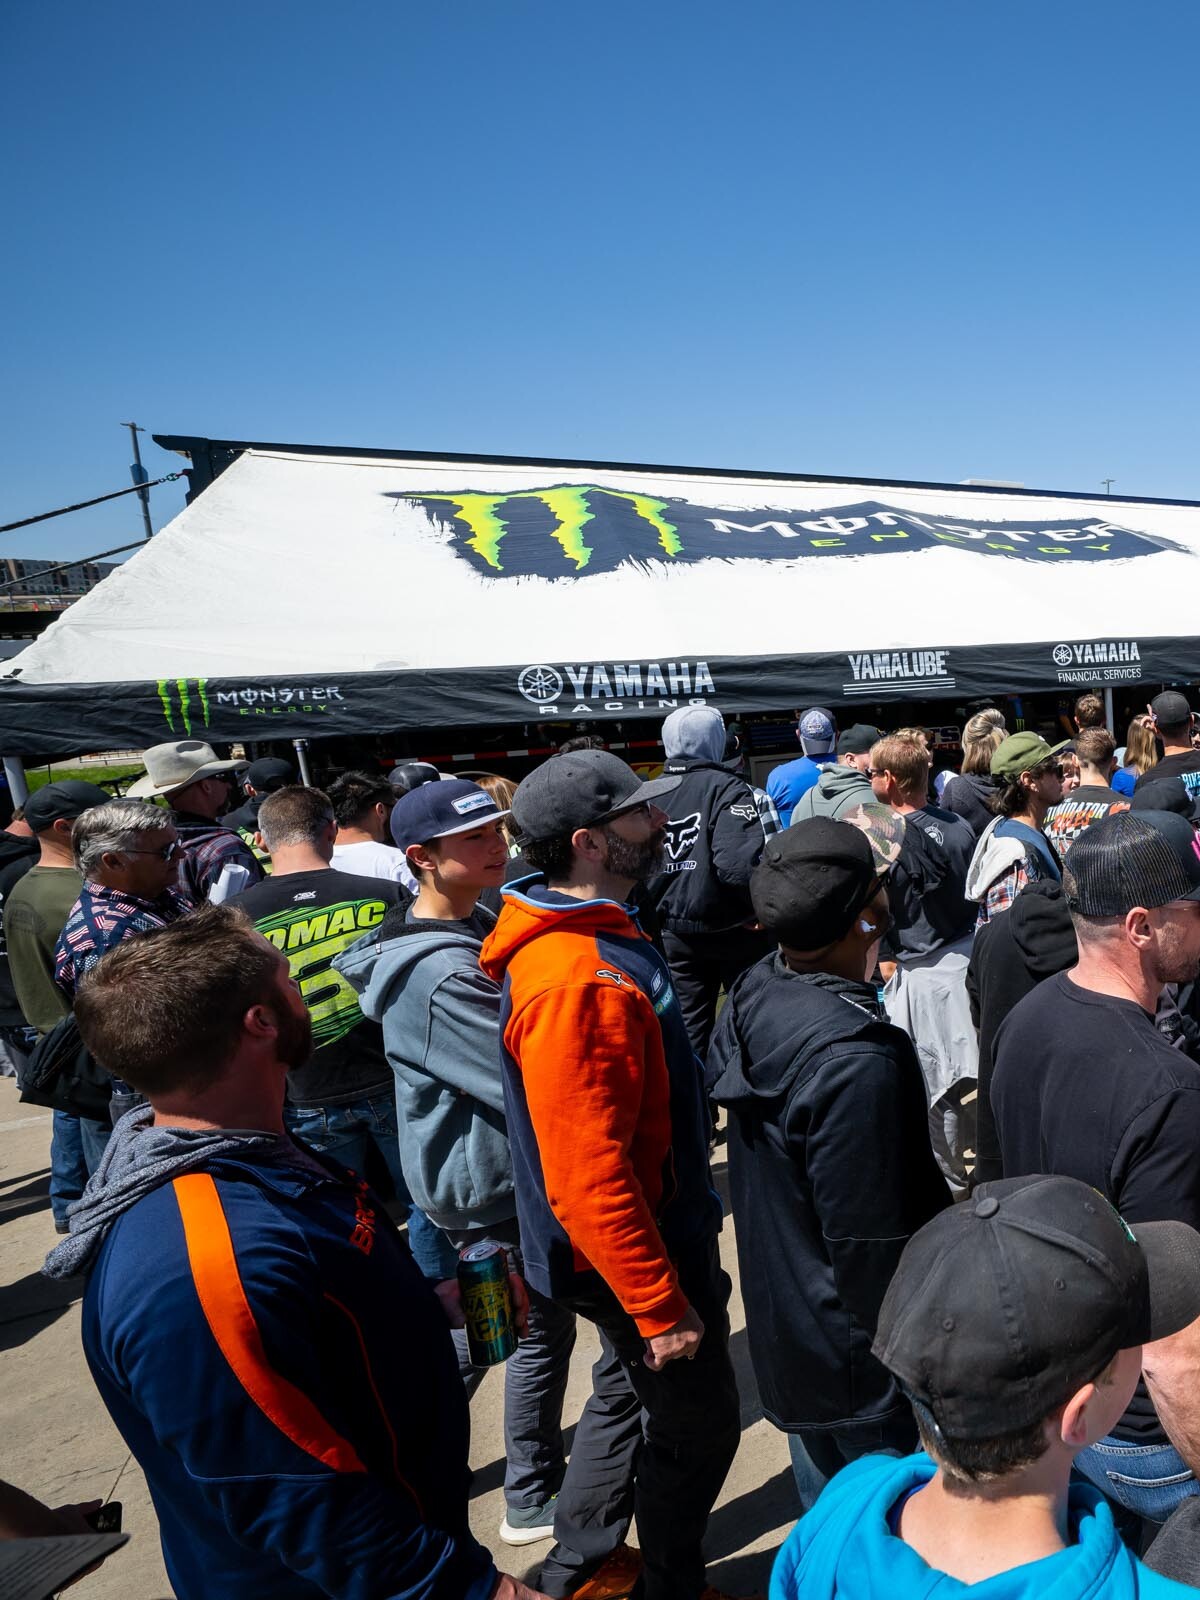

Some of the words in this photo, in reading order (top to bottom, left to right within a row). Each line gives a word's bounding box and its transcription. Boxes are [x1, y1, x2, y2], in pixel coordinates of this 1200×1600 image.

[1072, 642, 1140, 663] YAMAHA
[848, 651, 948, 680] YAMALUBE
[1058, 670, 1102, 683] FINANCIAL
[1104, 668, 1142, 680] SERVICES
[564, 661, 715, 699] YAMAHA
[217, 686, 344, 706] MONSTER
[539, 698, 707, 714] RACING
[240, 704, 327, 715] ENERGY
[263, 901, 387, 950] OMAC
